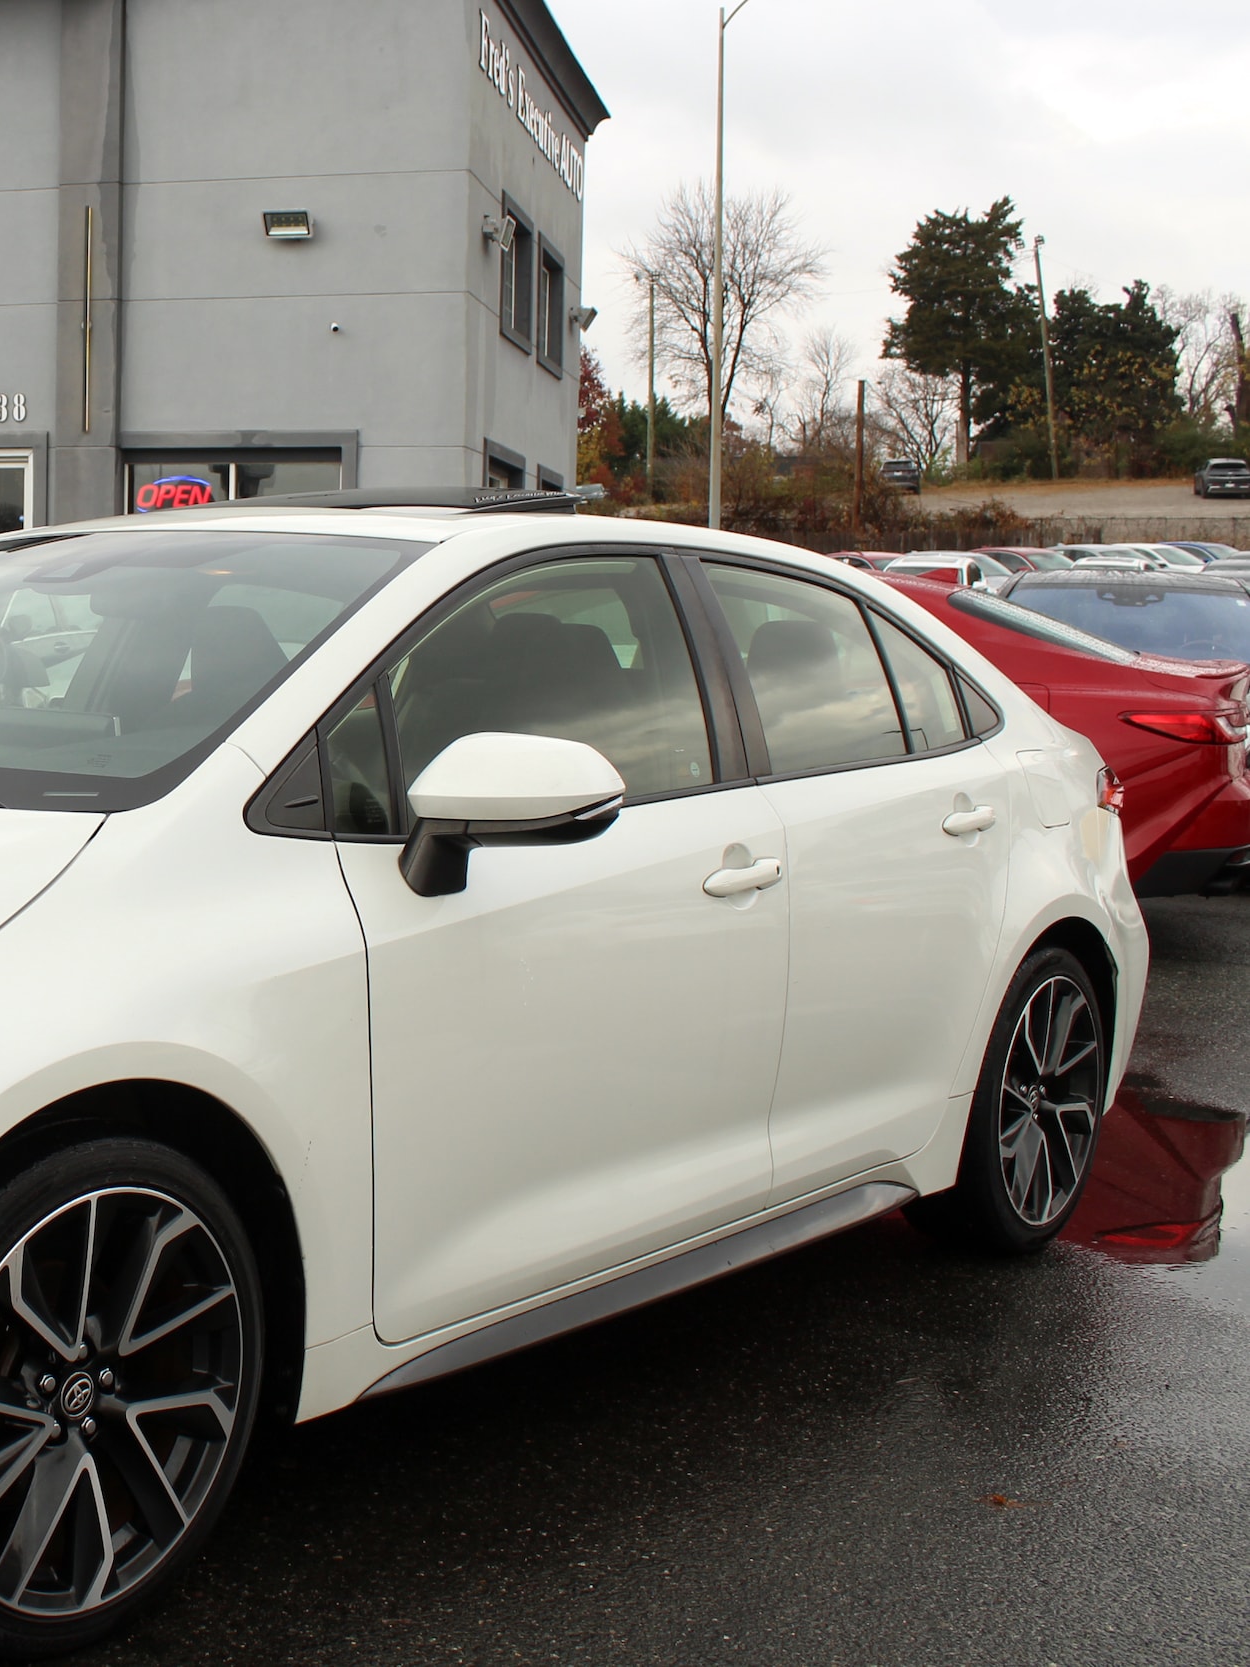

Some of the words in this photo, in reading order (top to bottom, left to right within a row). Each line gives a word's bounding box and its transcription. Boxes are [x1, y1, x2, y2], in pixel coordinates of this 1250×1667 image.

[479, 8, 514, 109] Fred's
[516, 64, 560, 172] Executive
[560, 131, 583, 203] AUTO
[136, 484, 212, 509] OPEN
